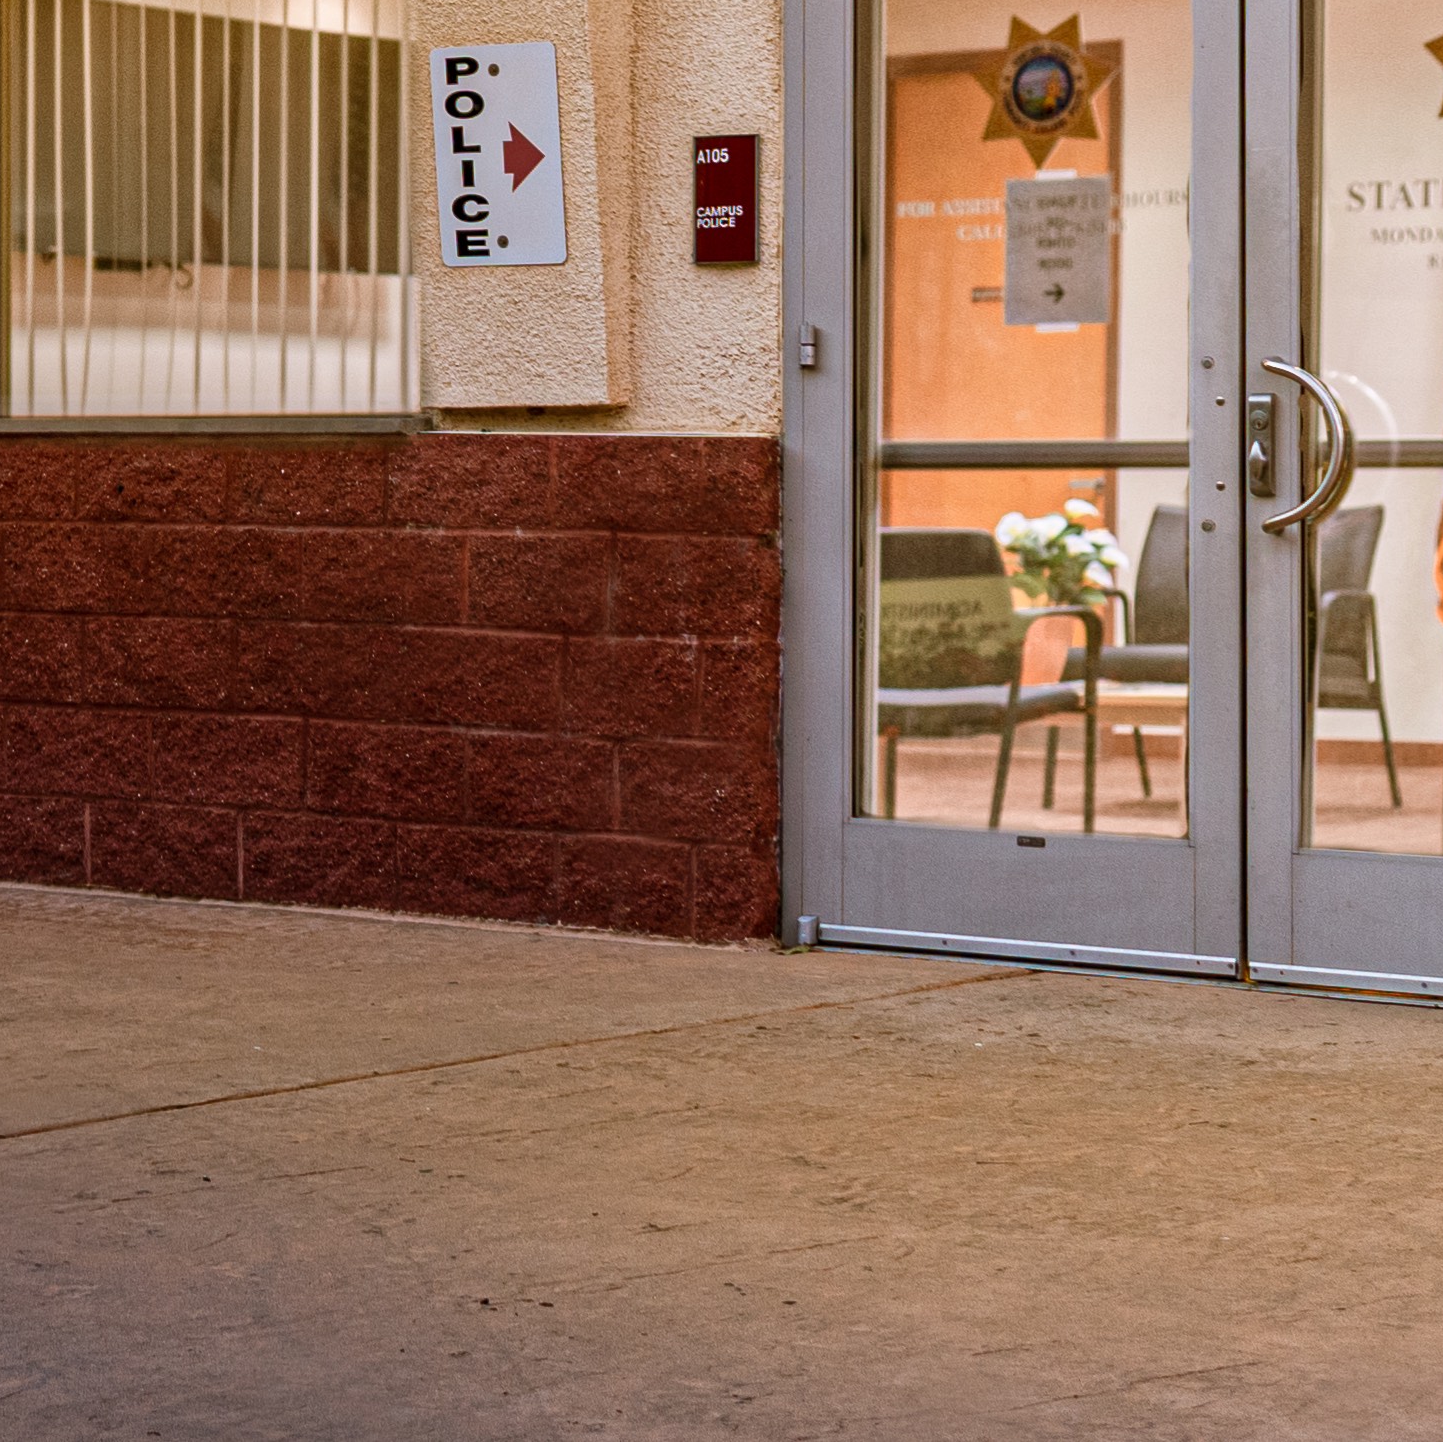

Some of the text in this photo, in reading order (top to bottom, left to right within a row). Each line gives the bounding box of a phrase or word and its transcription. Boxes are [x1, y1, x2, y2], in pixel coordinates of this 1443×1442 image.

[445, 56, 490, 258] POLICE
[697, 148, 729, 164] A105
[697, 205, 743, 217] CAMPUS
[697, 216, 736, 229] POLICE
